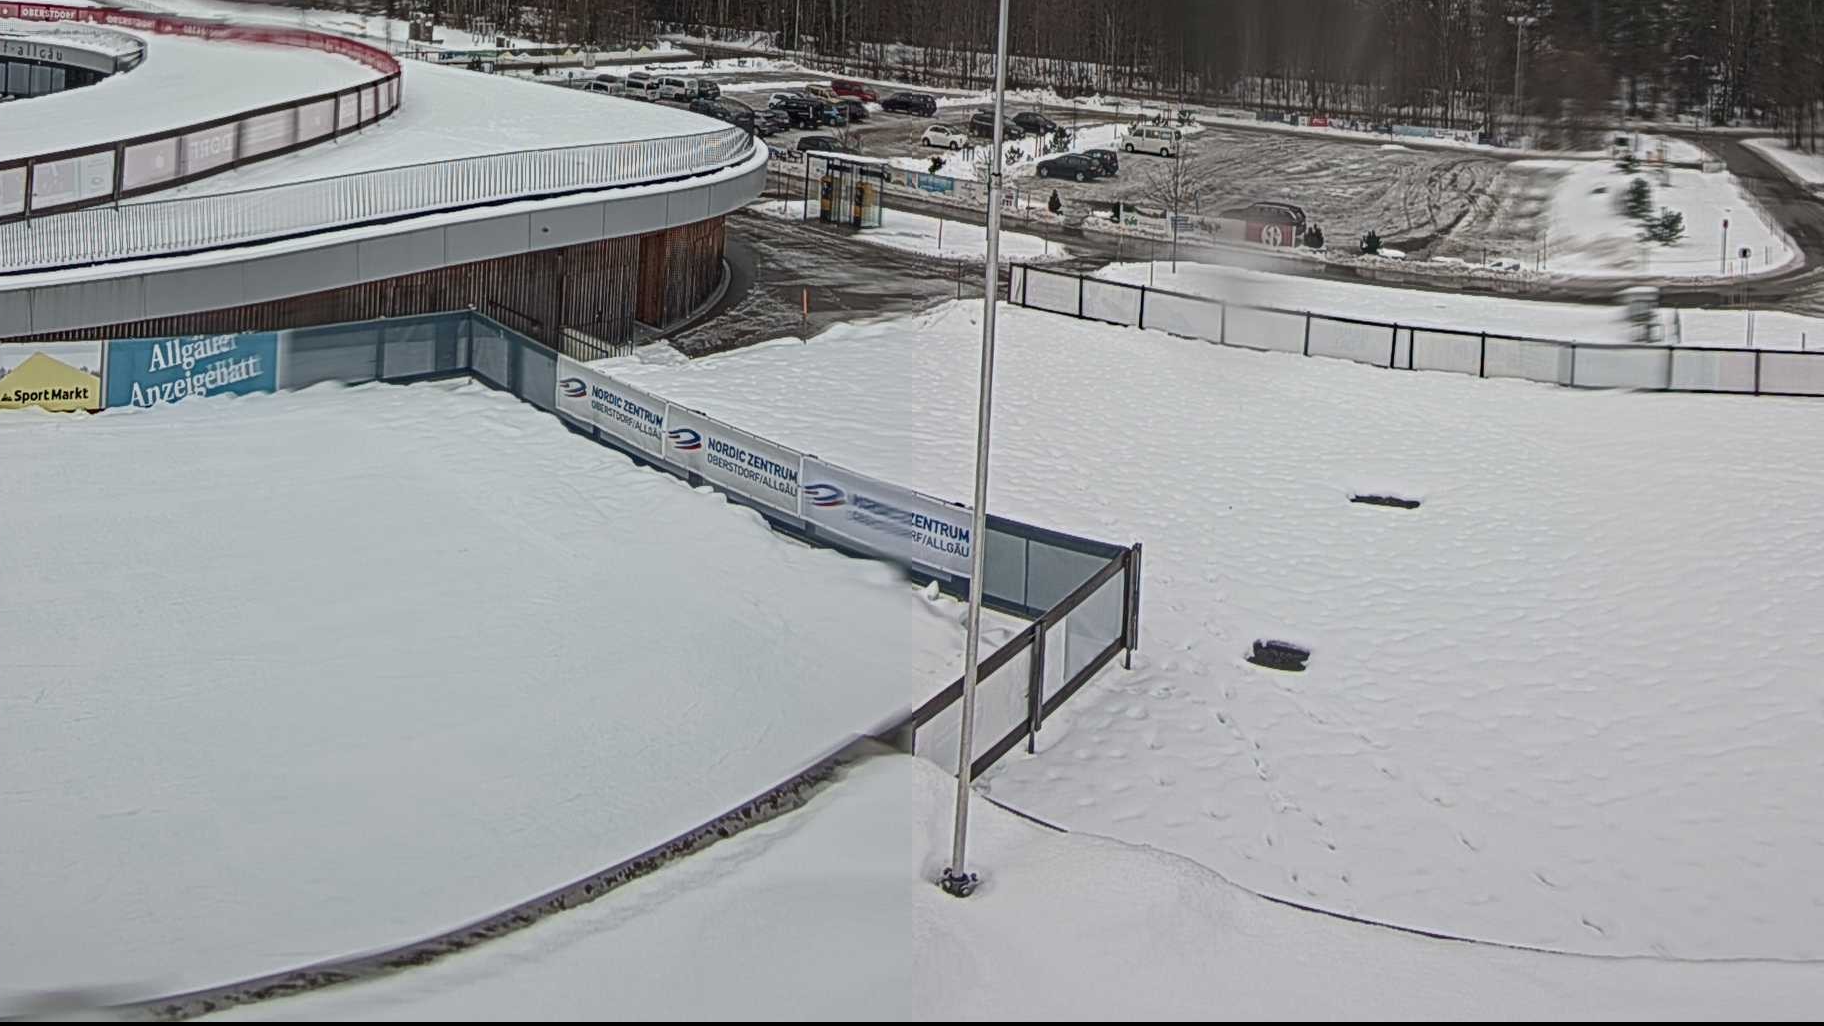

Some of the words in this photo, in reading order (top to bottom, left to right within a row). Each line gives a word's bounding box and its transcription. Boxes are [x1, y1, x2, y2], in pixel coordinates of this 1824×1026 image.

[22, 6, 76, 20] OBERSTDORF
[591, 385, 623, 409] NORDIC
[623, 398, 664, 426] ZENTRUM
[708, 437, 746, 462] NORDIC
[747, 452, 799, 484] ZENTRUM
